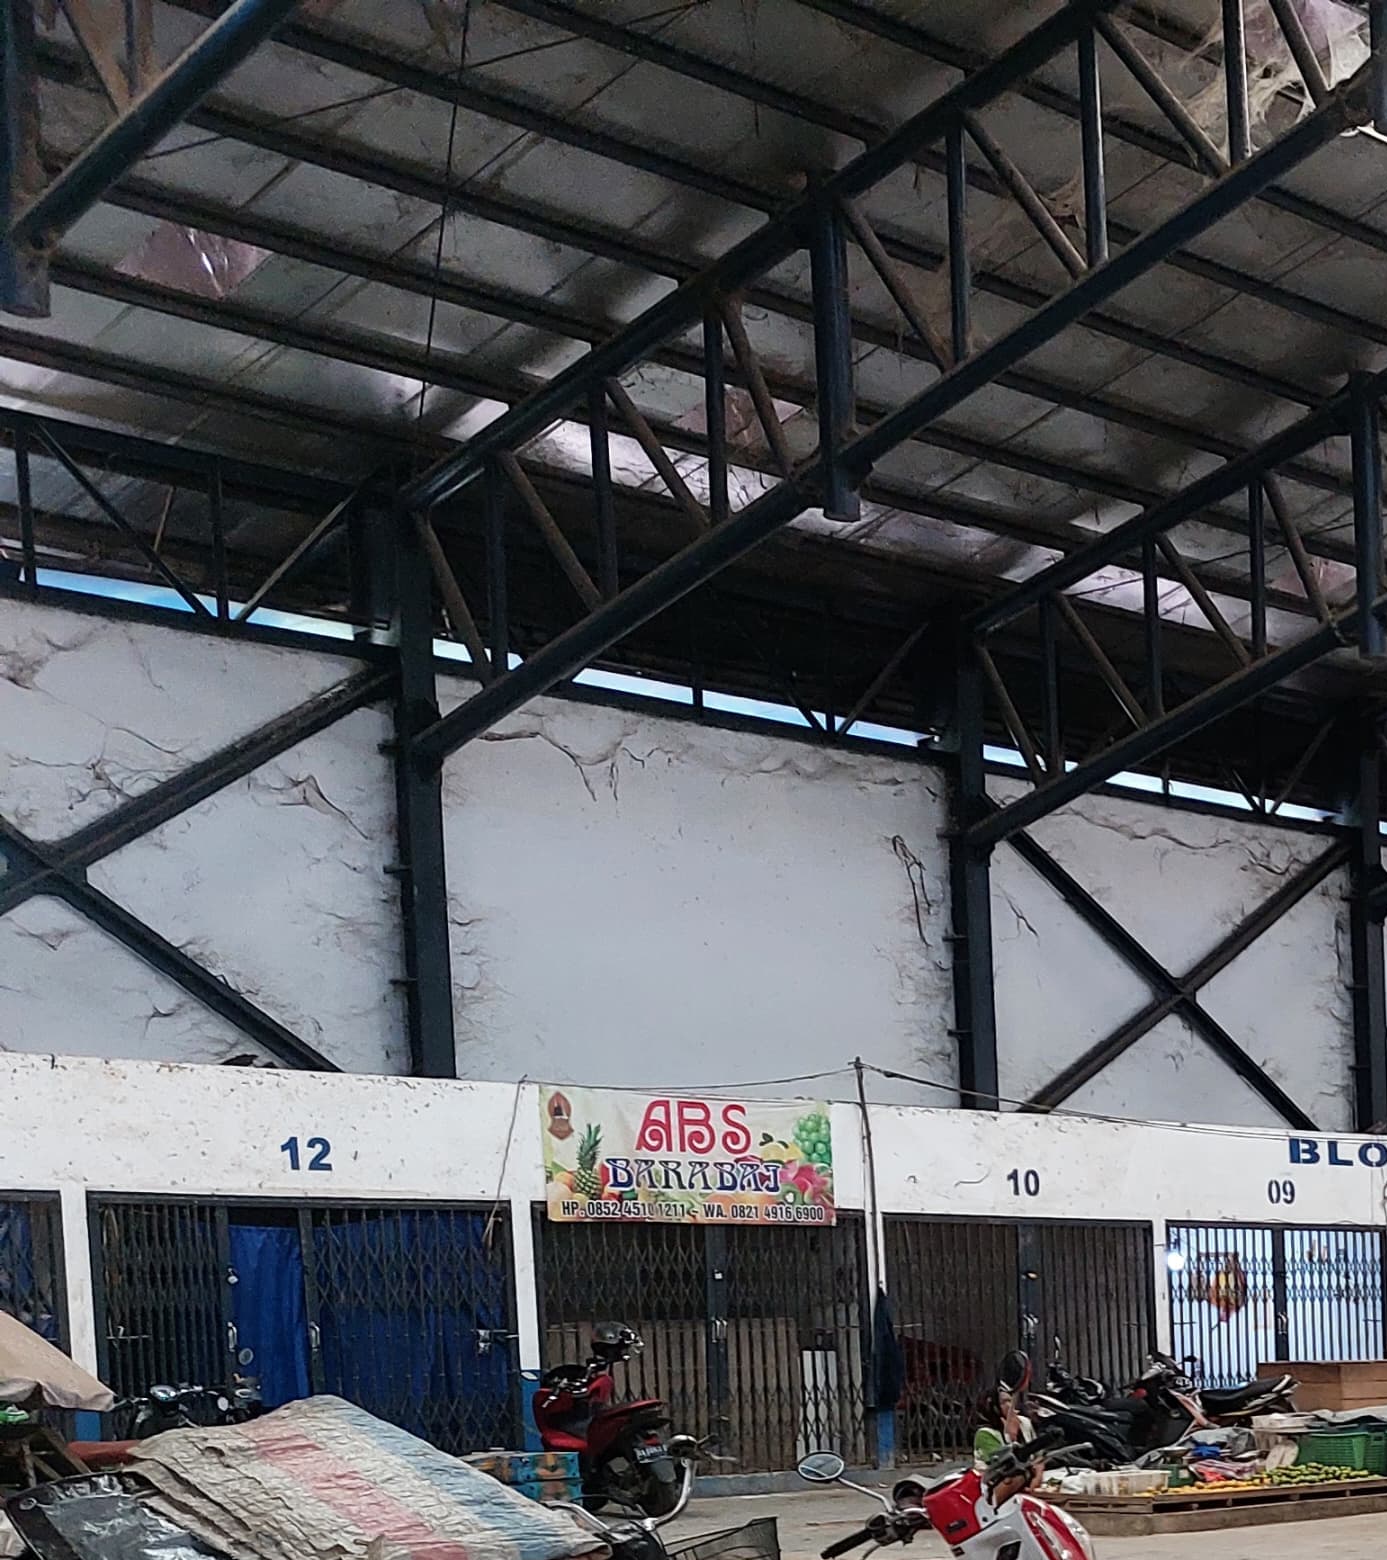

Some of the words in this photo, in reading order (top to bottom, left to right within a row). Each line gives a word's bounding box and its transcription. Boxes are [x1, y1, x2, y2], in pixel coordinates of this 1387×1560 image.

[635, 1100, 752, 1155] ABS
[281, 1136, 333, 1171] 12
[1007, 1168, 1040, 1197] 10
[1268, 1179, 1296, 1204] 09
[587, 1201, 619, 1217] 0852
[703, 1204, 727, 1218] WA.
[731, 1205, 759, 1219] 0821
[764, 1206, 792, 1220] 4916
[796, 1207, 824, 1221] 6900
